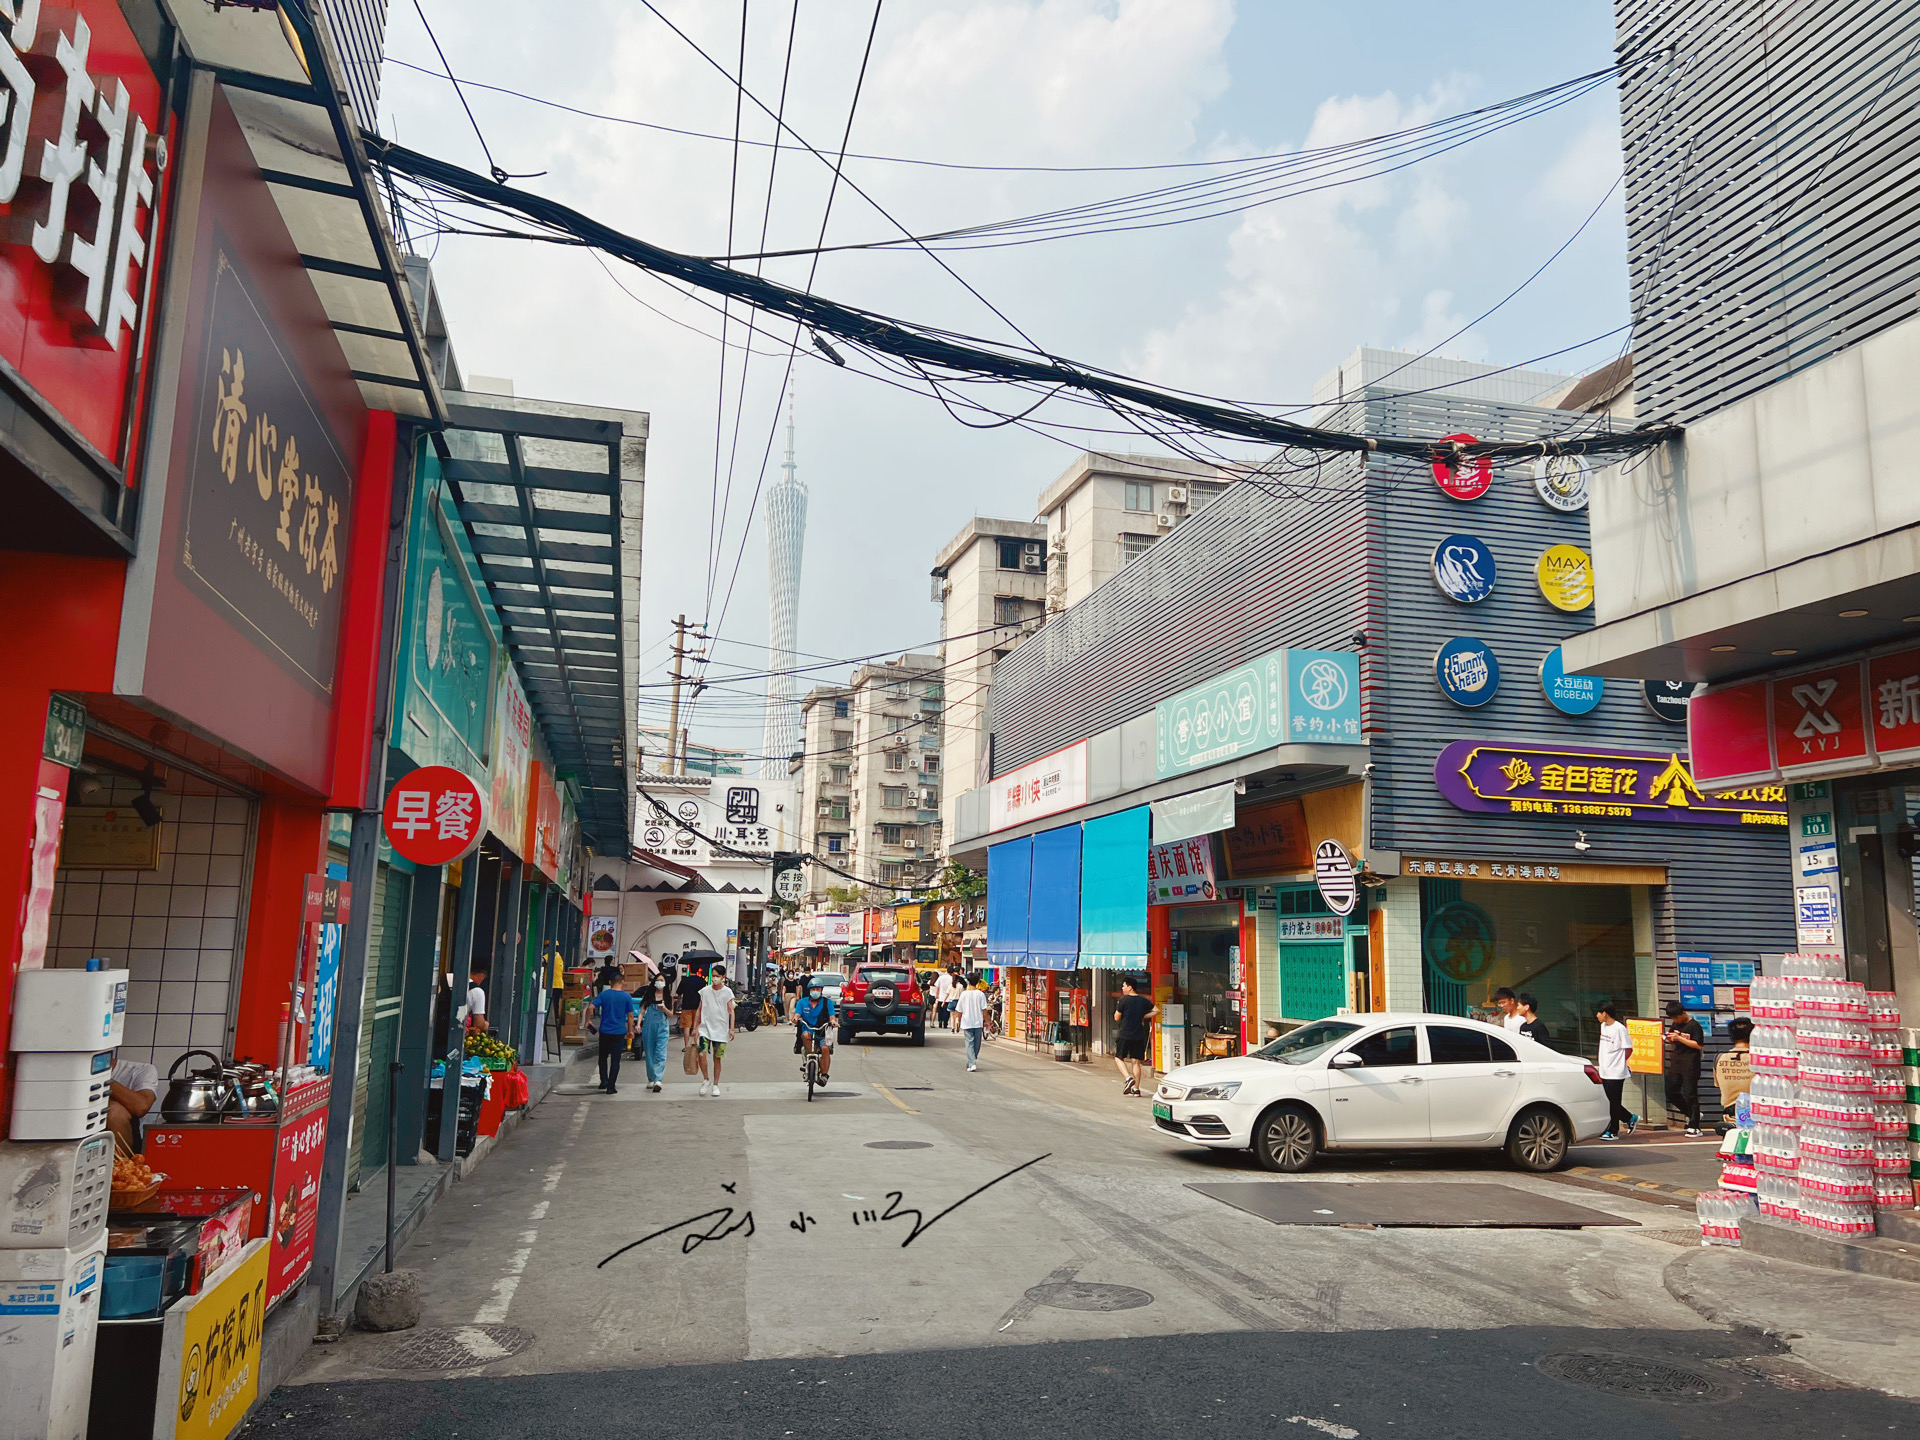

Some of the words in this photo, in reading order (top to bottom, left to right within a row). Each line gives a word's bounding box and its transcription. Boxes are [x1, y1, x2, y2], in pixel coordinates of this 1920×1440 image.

[213, 347, 338, 594] 清心堂凉茶
[1546, 555, 1587, 571] MAX
[1554, 677, 1593, 690] 大豆运动
[1554, 690, 1594, 700] BIGBEAN
[1178, 695, 1251, 743] 誉约小馆
[1291, 715, 1359, 735] 誉约小馆
[1802, 736, 1840, 754] XYJ
[1539, 763, 1638, 795] 金色莲花
[391, 791, 474, 841] 早餐
[1562, 804, 1583, 814] 136
[1606, 806, 1632, 817] 5878
[1806, 824, 1826, 834] 101
[1409, 861, 1480, 876] 东南亚美食
[1491, 863, 1560, 879] 无骨海南鸡
[782, 892, 799, 900] SPA
[203, 1279, 263, 1398] 柠檬凤爪
